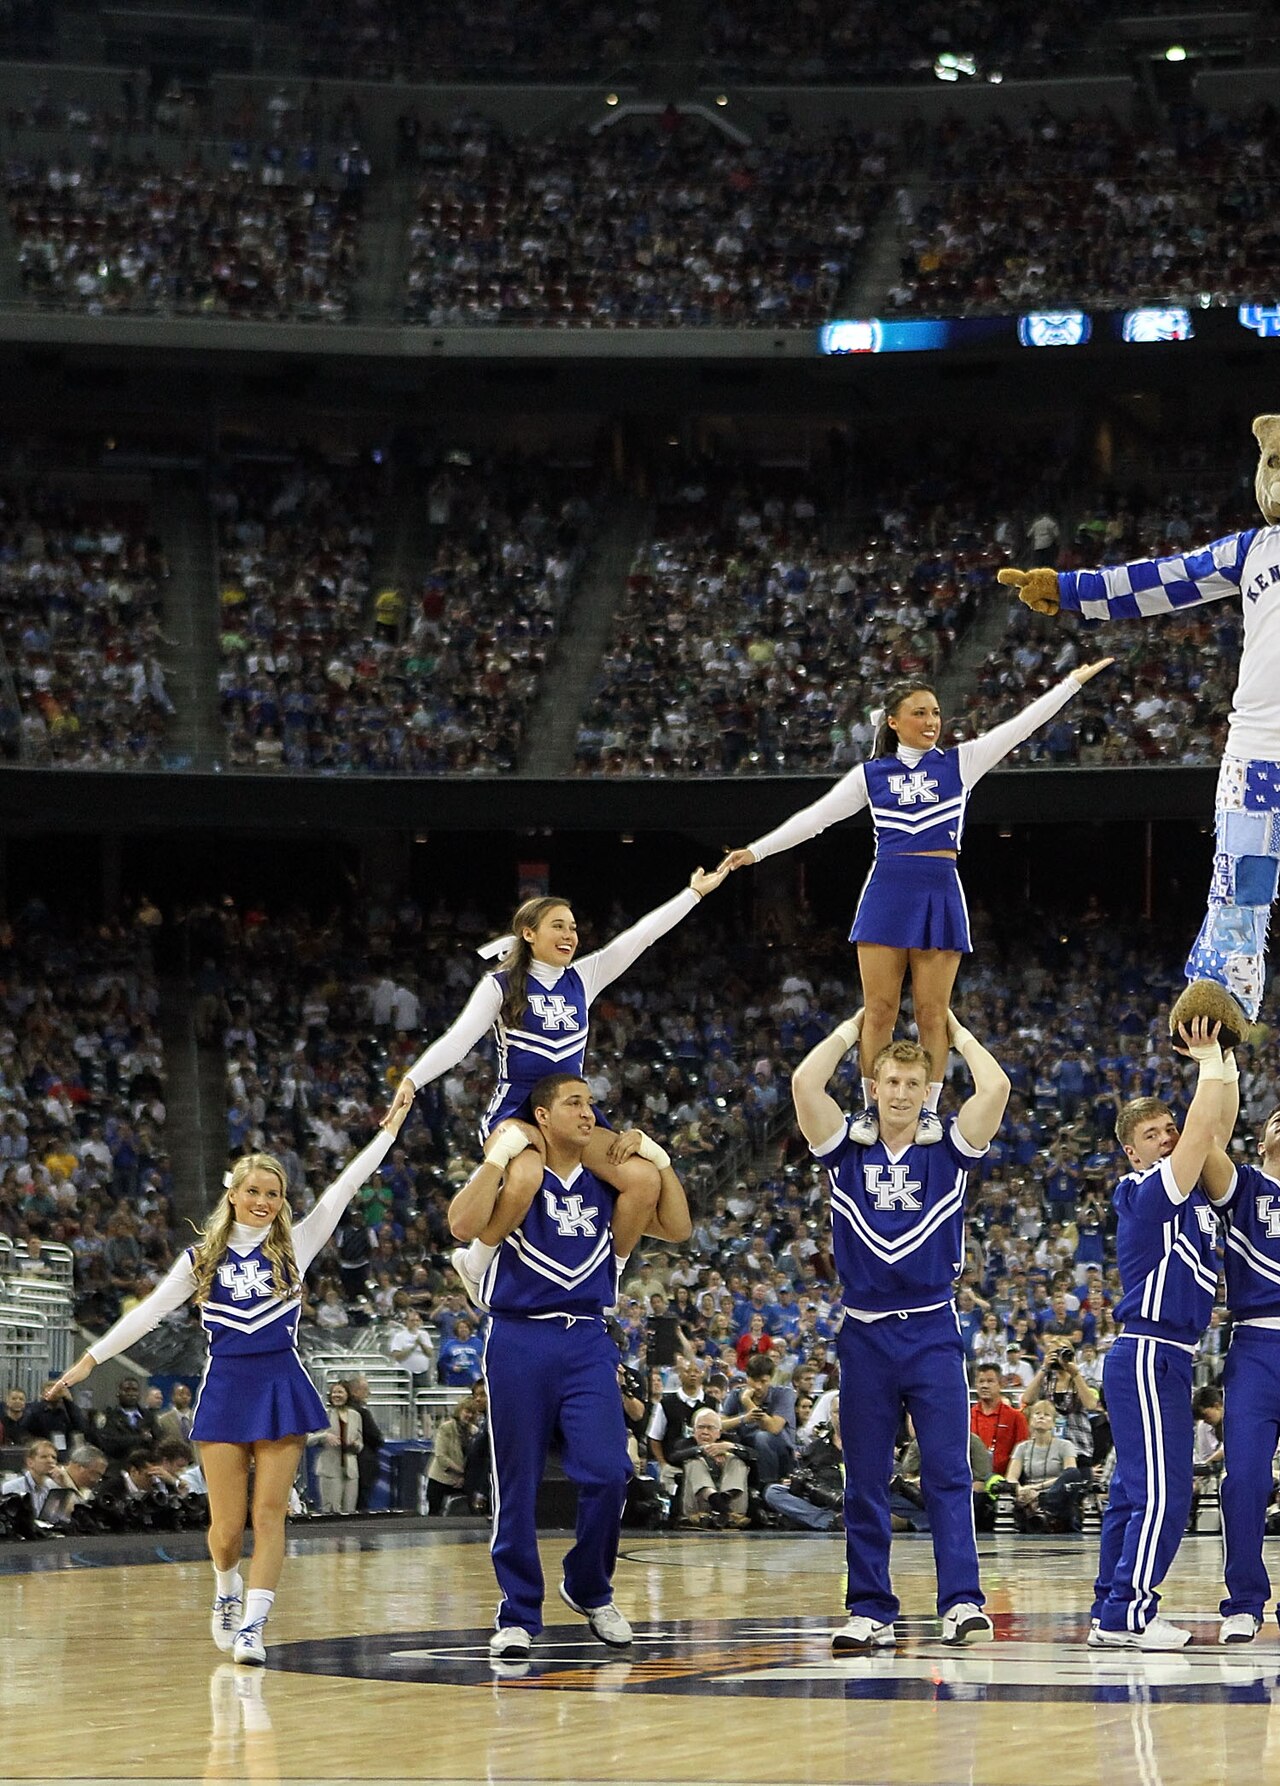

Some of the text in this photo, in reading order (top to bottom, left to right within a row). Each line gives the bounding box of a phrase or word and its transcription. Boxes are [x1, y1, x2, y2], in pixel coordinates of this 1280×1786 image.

[888, 771, 939, 806] UK
[527, 994, 579, 1030] UK
[864, 1165, 922, 1211] UK
[543, 1189, 599, 1237] UK
[217, 1260, 274, 1301] UK
